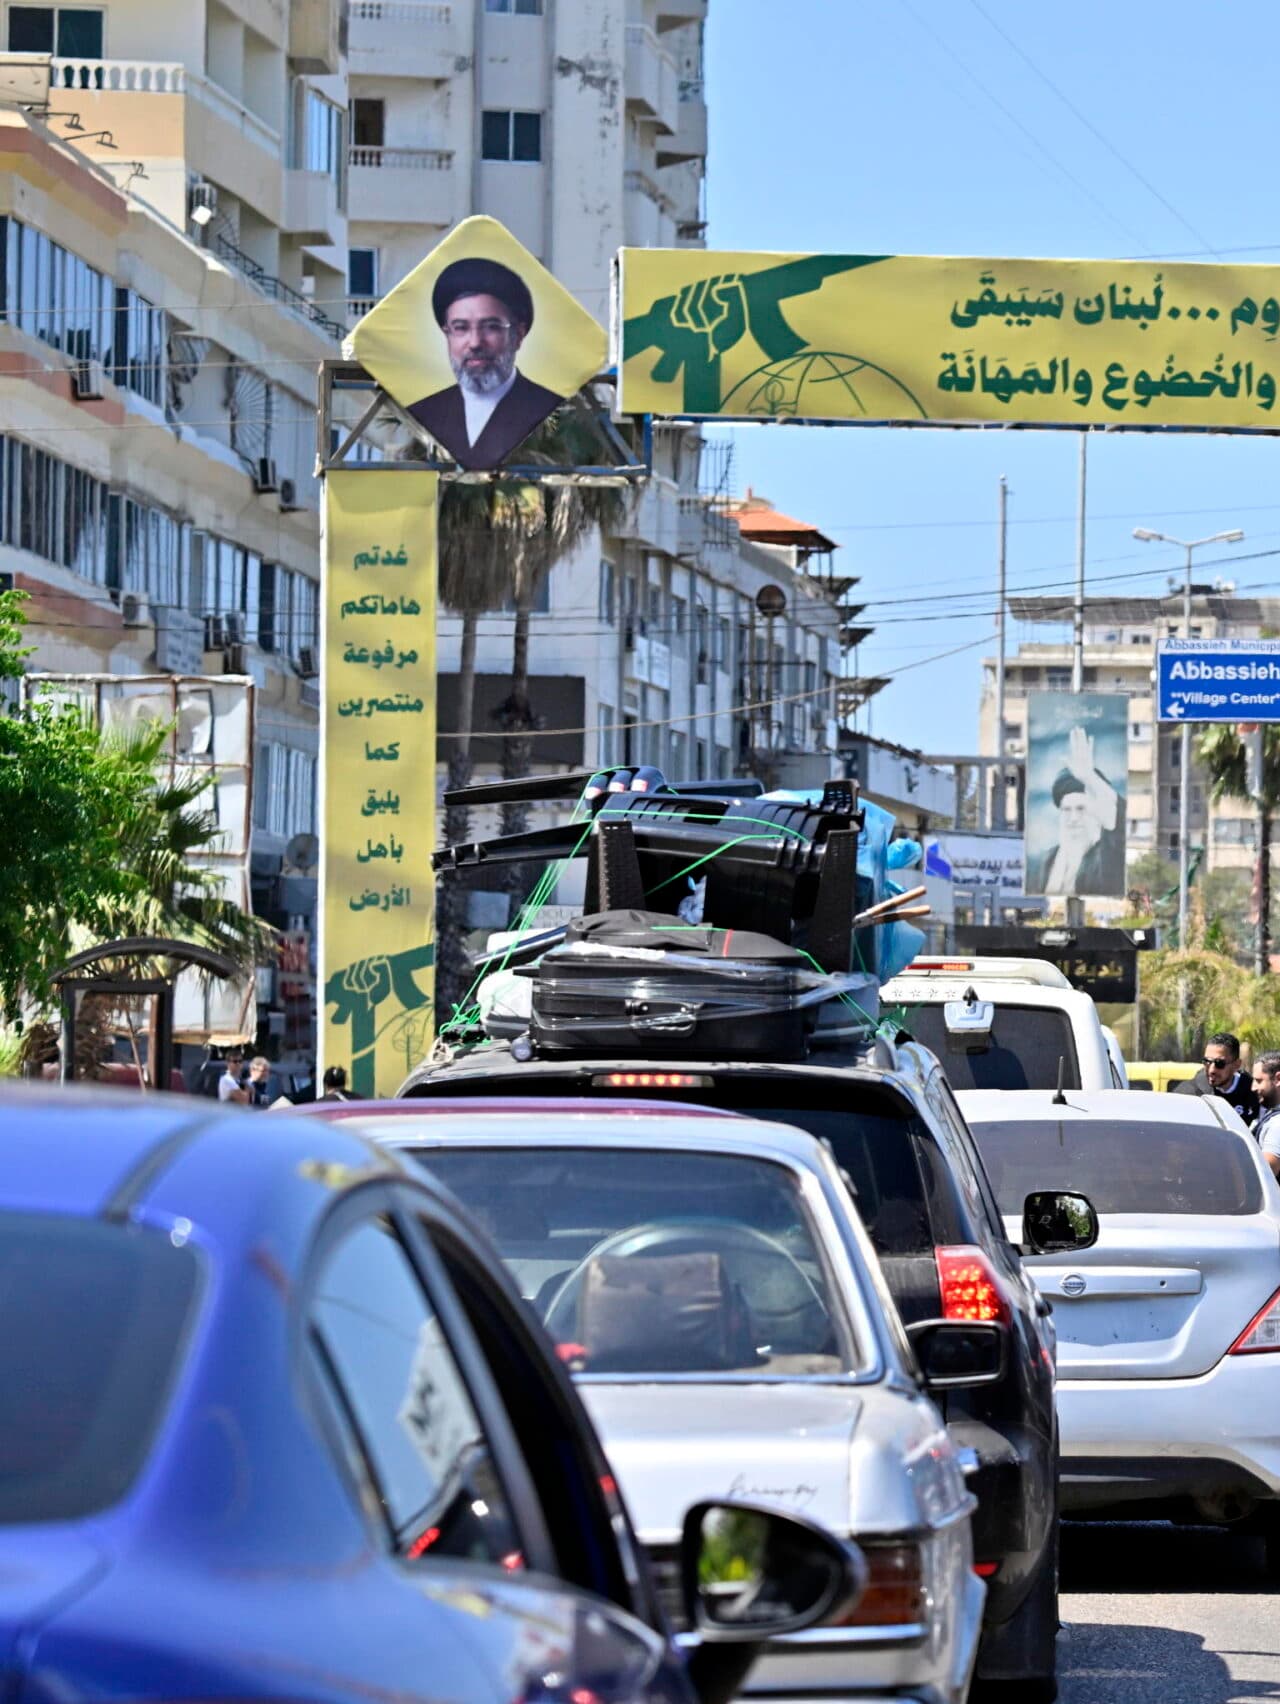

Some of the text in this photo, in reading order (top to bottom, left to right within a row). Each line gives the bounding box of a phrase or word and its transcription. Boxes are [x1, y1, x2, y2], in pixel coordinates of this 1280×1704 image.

[343, 639, 419, 669] مرفوعة
[1165, 640, 1227, 650] Abbassieh
[337, 694, 424, 718] منتصرين
[365, 741, 400, 761] كما
[361, 789, 400, 816] يليق
[357, 834, 403, 863] بأهل
[349, 884, 410, 912] الأرض
